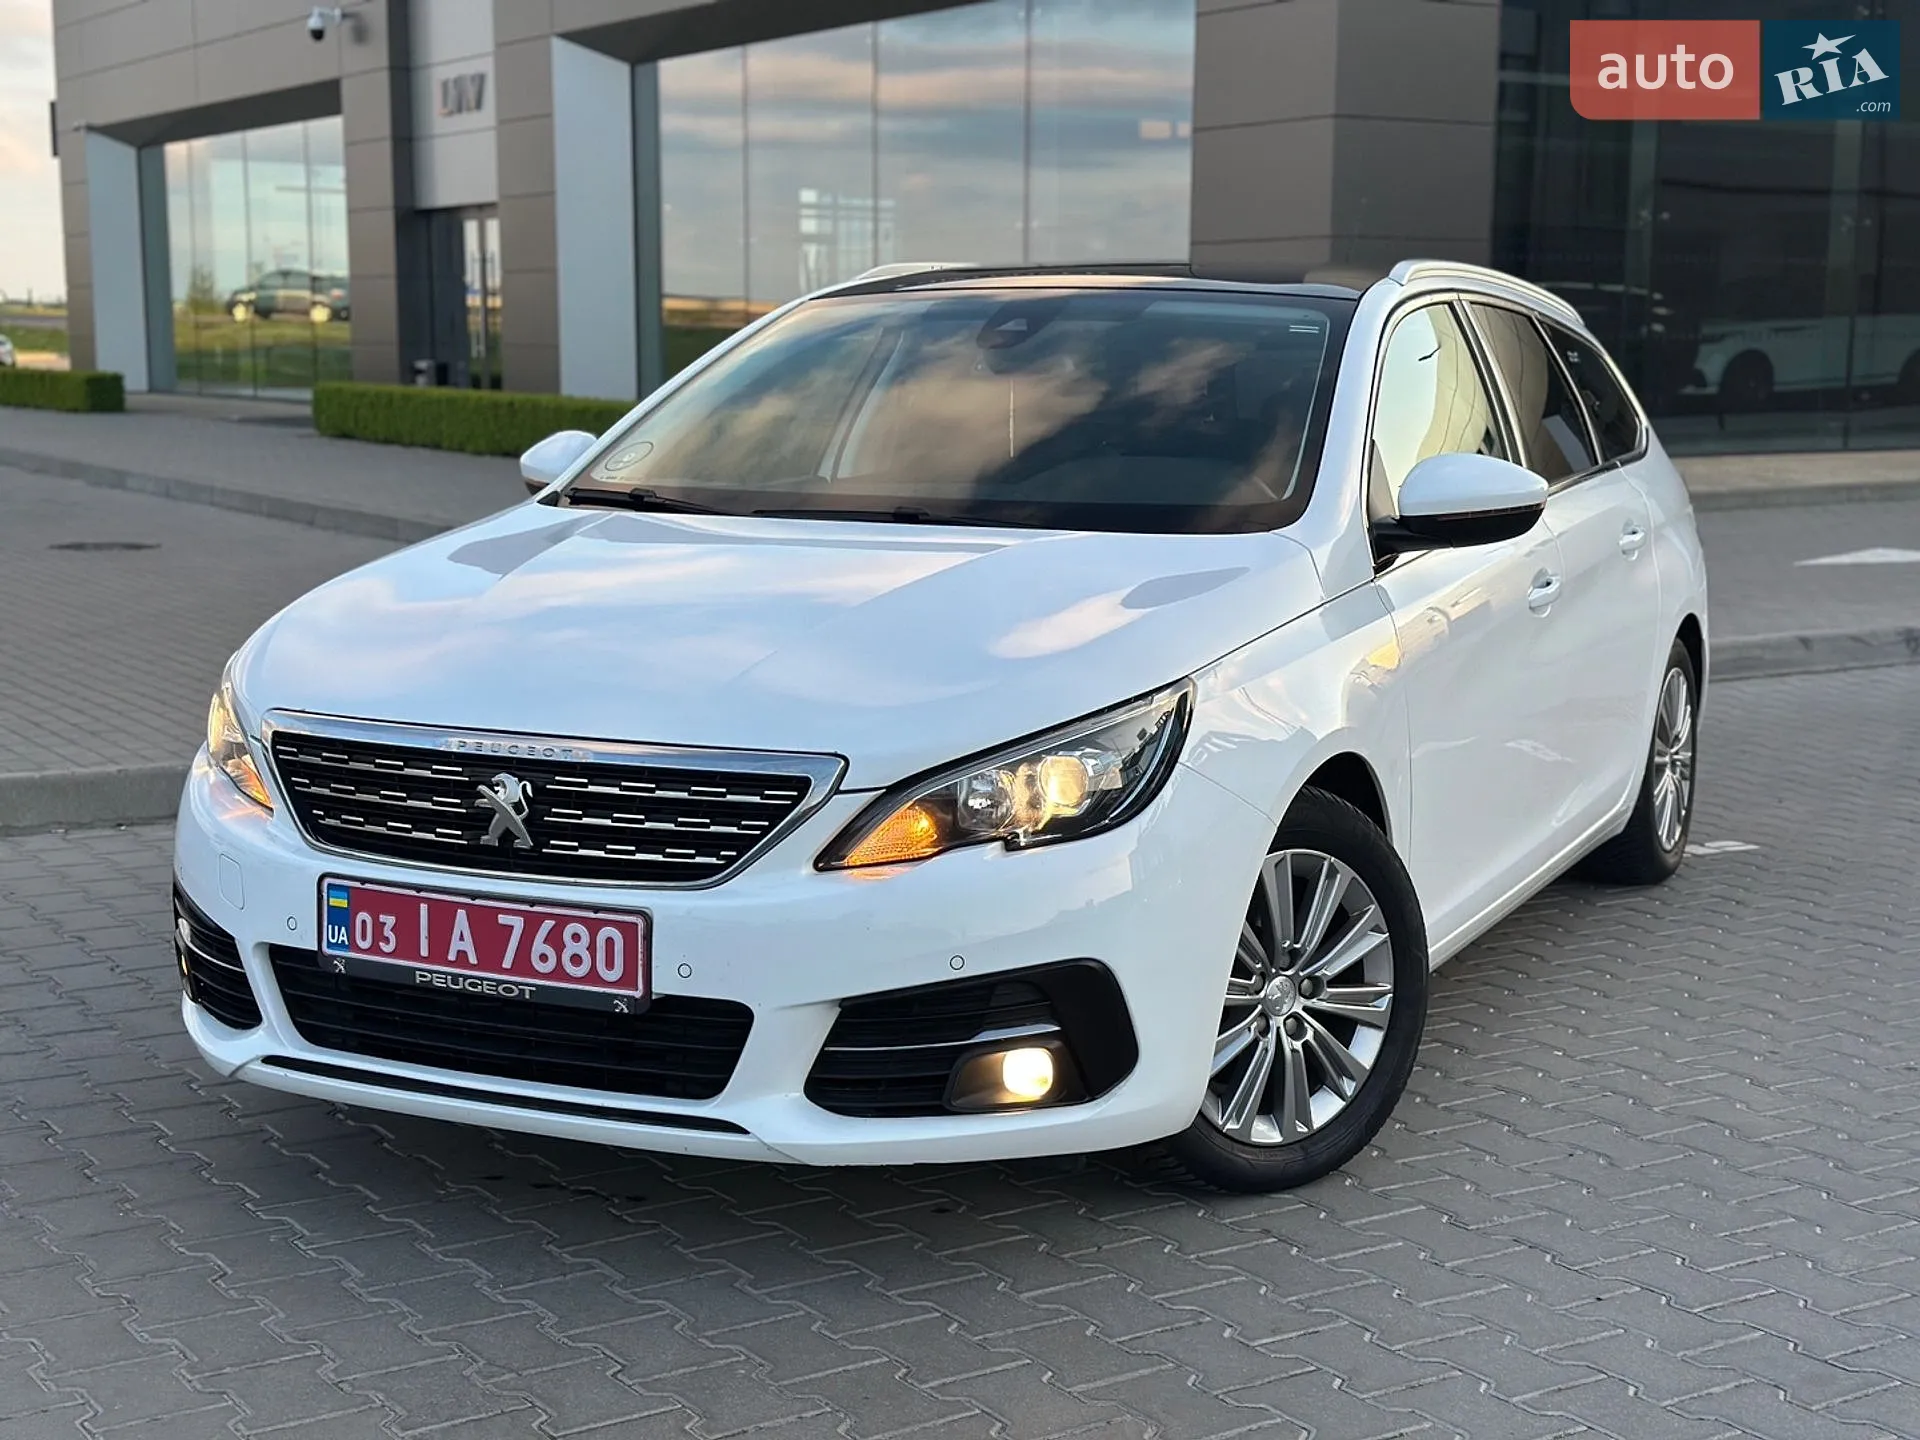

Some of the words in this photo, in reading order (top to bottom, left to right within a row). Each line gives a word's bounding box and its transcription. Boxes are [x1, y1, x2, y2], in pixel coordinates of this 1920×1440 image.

[456, 740, 573, 759] PEUGEOT
[328, 924, 349, 945] UA
[355, 911, 397, 953] 03
[497, 914, 624, 983] 7680
[415, 970, 536, 1000] PEUGEOT
